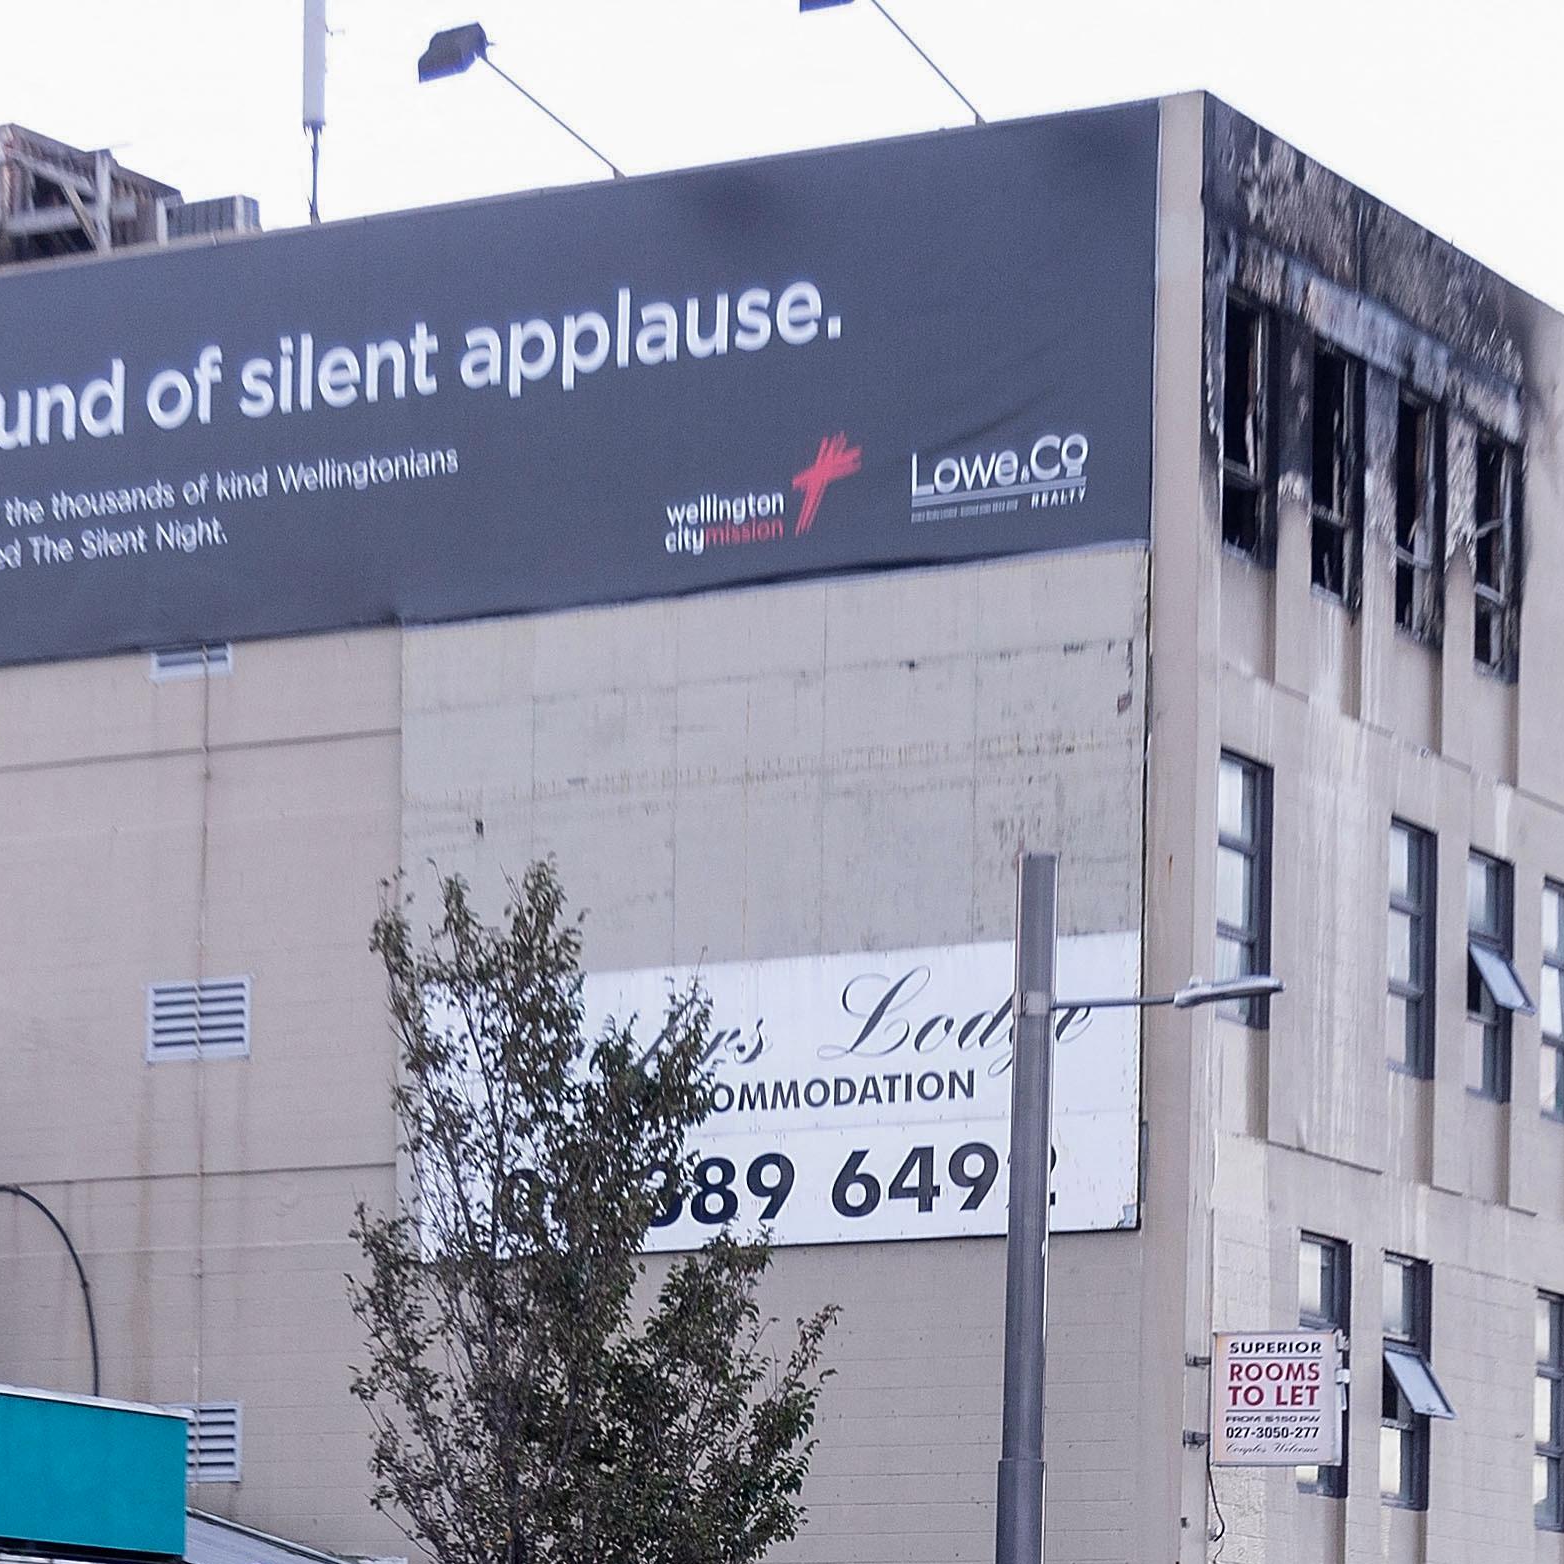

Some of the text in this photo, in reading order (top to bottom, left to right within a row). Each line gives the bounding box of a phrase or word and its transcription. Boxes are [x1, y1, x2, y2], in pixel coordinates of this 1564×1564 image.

[147, 345, 223, 429] of
[238, 322, 438, 419] silent
[460, 281, 841, 398] applause.
[5, 496, 44, 529] the
[50, 479, 175, 521] thousands
[182, 473, 210, 506] of
[216, 467, 268, 500] kind
[278, 447, 459, 495] Wellingtonians
[667, 492, 784, 527] wellington
[27, 535, 74, 566] The
[81, 526, 148, 560] Silent
[155, 516, 228, 553] Night.
[1229, 1341, 1322, 1354] SUPERIOR
[1229, 1362, 1320, 1382] ROOMS
[1227, 1385, 1320, 1407] TO LET
[1225, 1426, 1320, 1439] 027-3050-277
